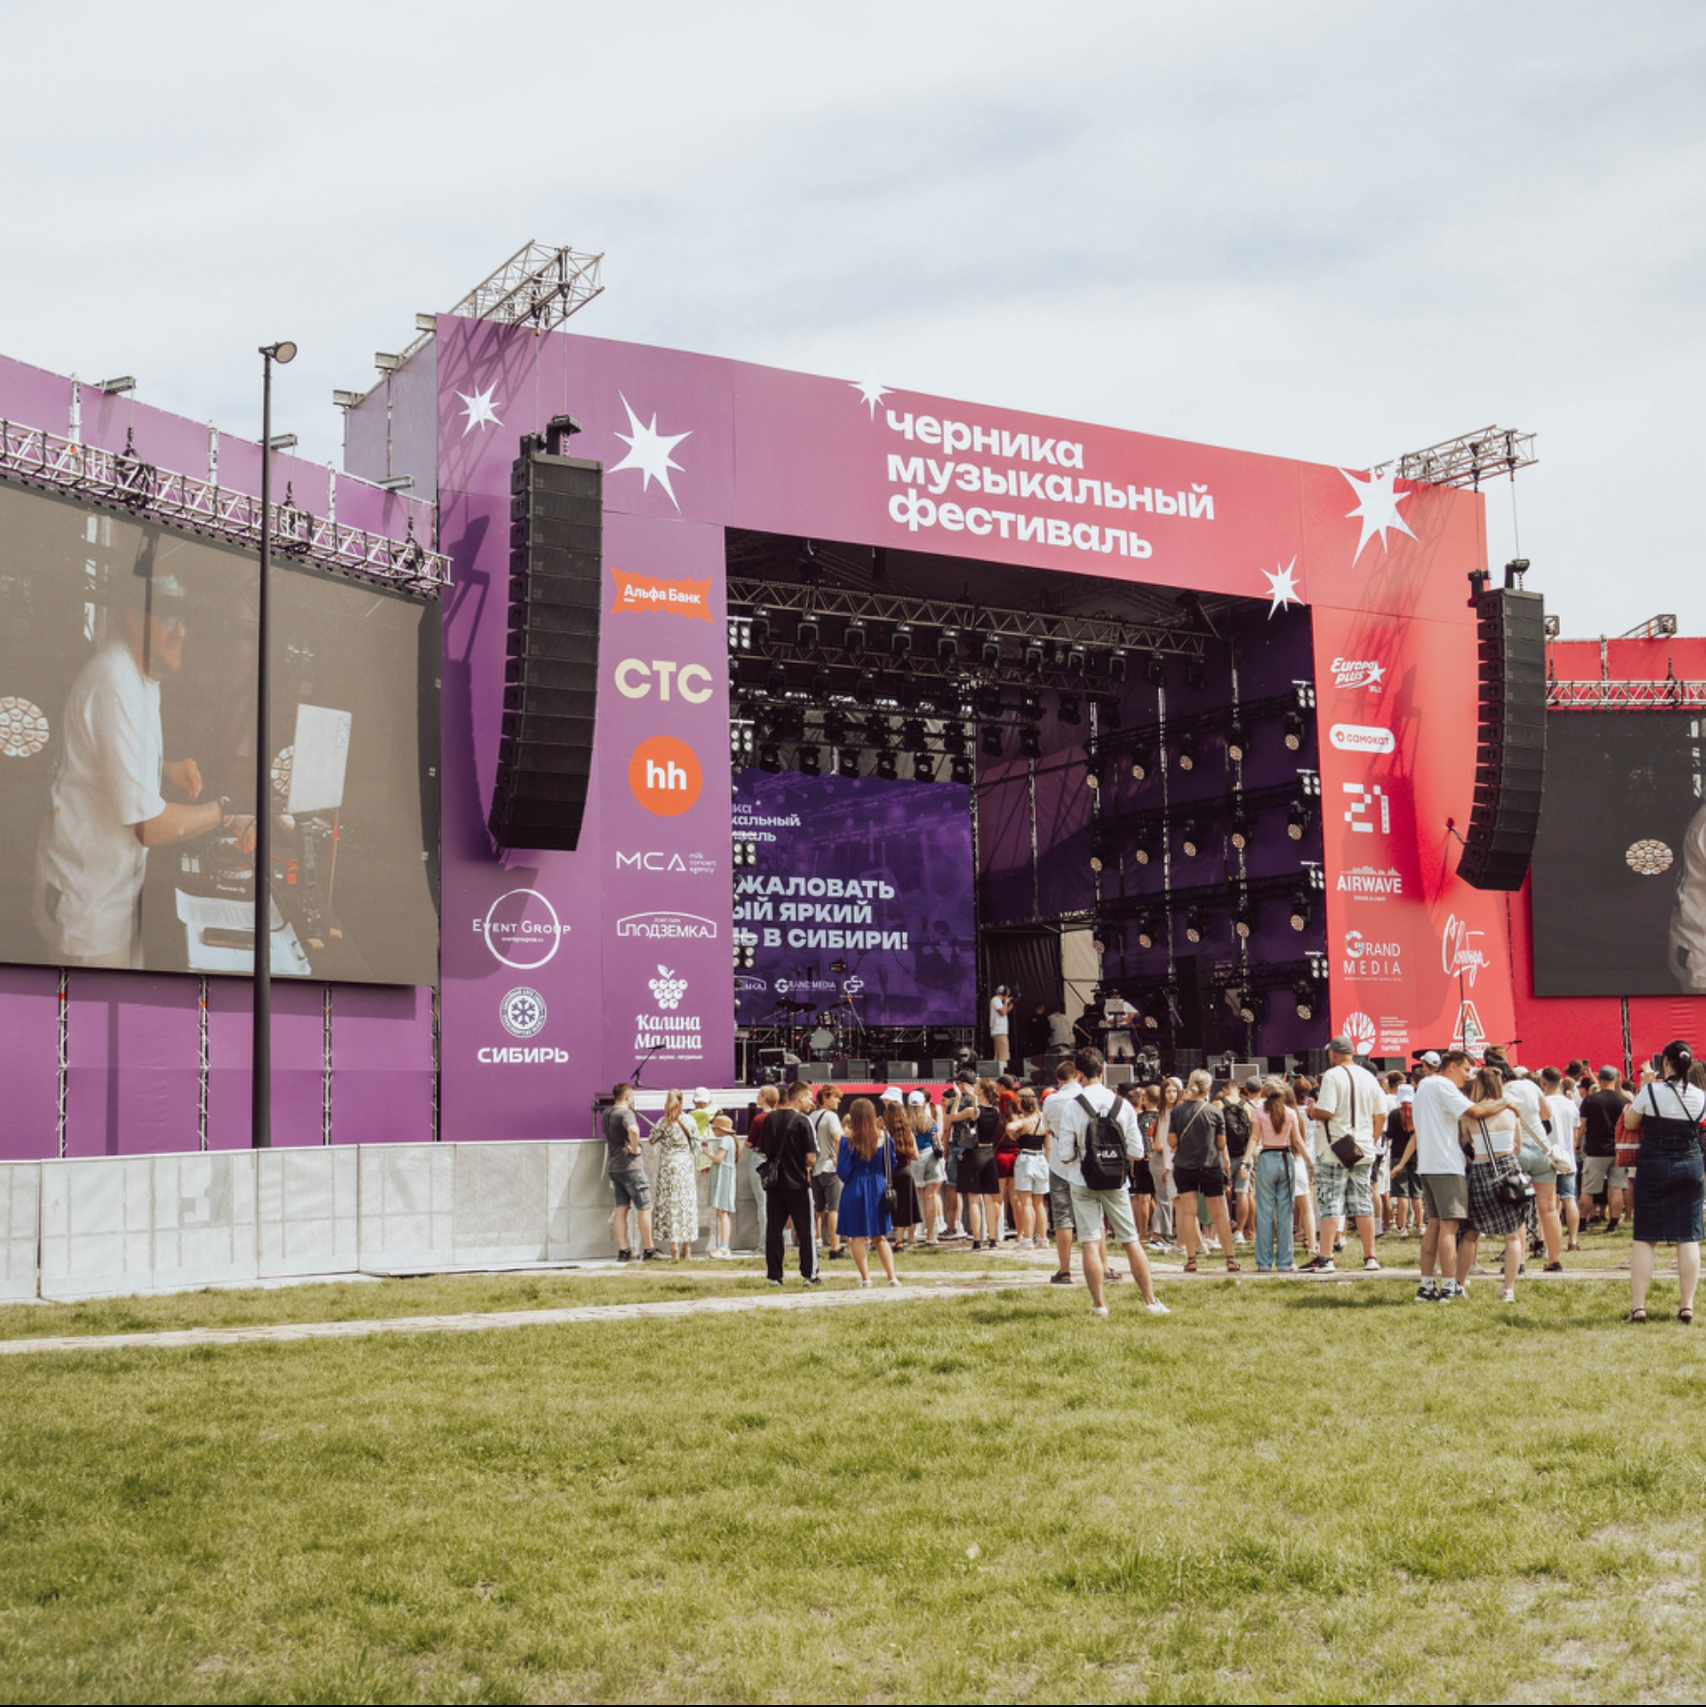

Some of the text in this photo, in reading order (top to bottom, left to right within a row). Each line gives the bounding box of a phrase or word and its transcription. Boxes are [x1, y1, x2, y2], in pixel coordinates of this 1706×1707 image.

[886, 409, 1084, 469] черника
[886, 453, 1215, 520] музыкальный
[888, 488, 1153, 559] фестиваль
[624, 583, 701, 604] Альфа Банк
[614, 657, 713, 704] СТС
[1346, 733, 1390, 746] самокат
[646, 759, 687, 790] hh
[1337, 875, 1402, 893] AIRWAVE
[779, 900, 872, 924] ЯРКИЙ
[626, 924, 710, 939] ПОДЗЕМКА
[763, 928, 782, 947] В
[787, 928, 909, 950] СИБИРИ!
[1345, 930, 1401, 958] GRAND
[1343, 960, 1402, 975] MEDIA
[635, 1014, 702, 1031] Калина
[634, 1033, 702, 1050] Малина
[477, 1047, 569, 1063] СИБИРЬ
